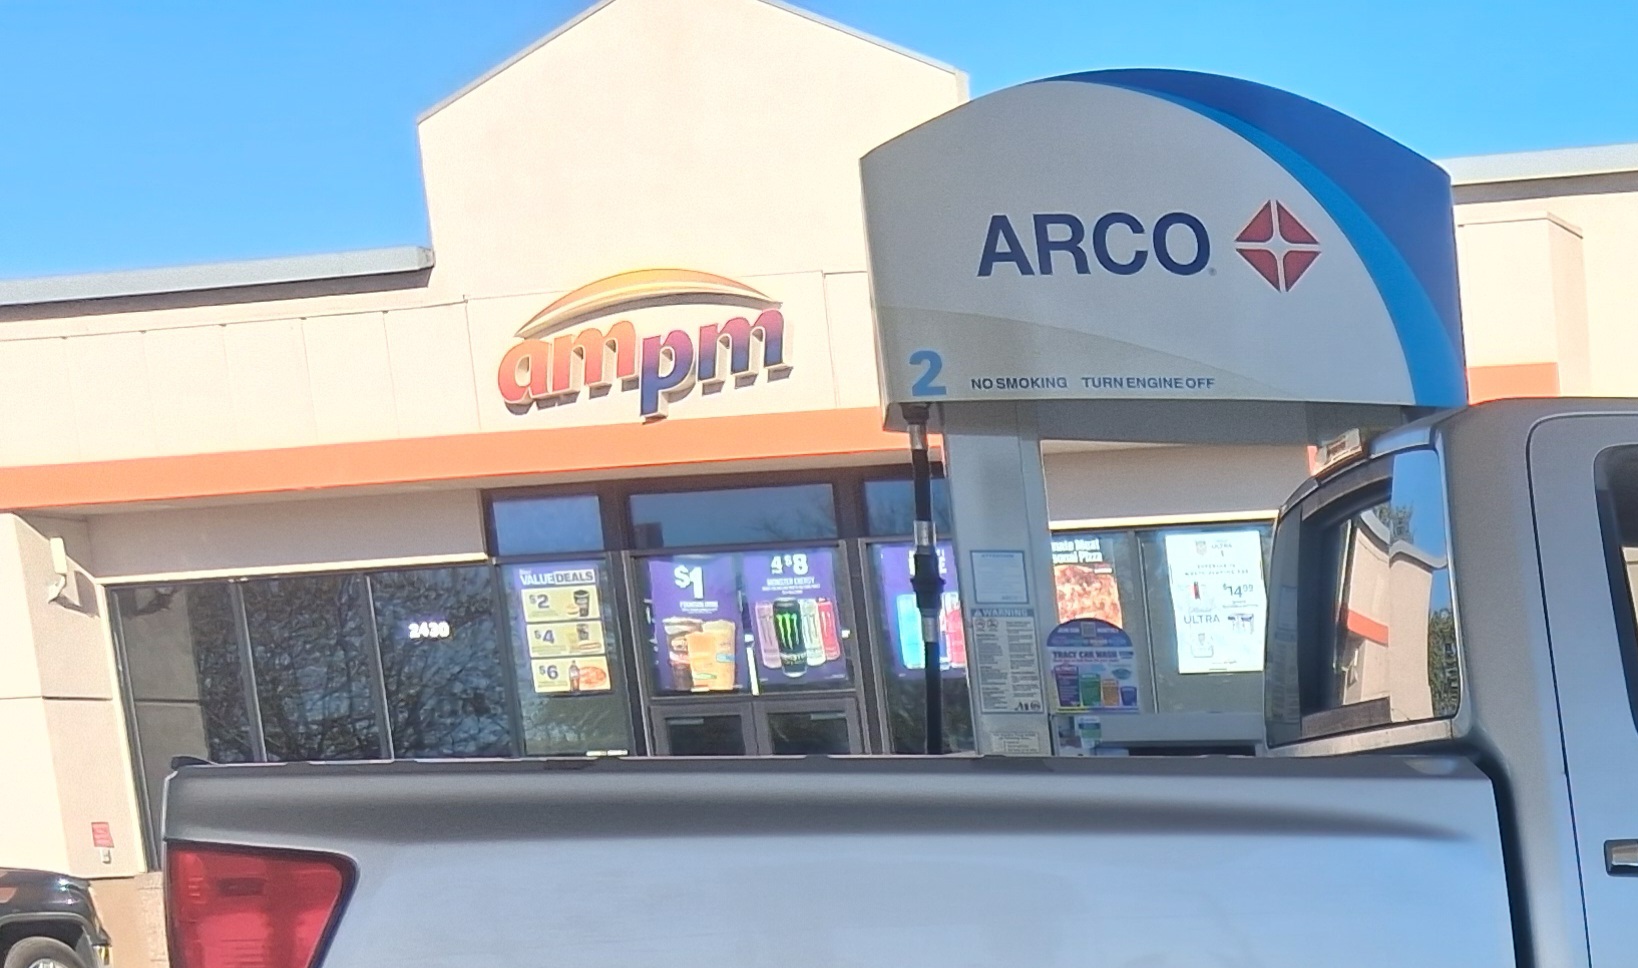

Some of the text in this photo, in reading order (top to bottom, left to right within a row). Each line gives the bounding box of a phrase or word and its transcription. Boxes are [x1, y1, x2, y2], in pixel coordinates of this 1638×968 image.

[977, 212, 1210, 277] ARCO
[498, 308, 786, 417] ampm
[909, 350, 947, 397] 2
[971, 376, 1216, 390] NO SMOKING TURN ENGINE OFF
[1078, 551, 1103, 563] Pizza
[520, 571, 594, 586] VALUE DEALS
[674, 564, 704, 599] $1
[529, 594, 549, 609] $2
[983, 608, 1028, 617] WARNING
[1183, 614, 1220, 625] ULTRA
[408, 621, 450, 639] 2430
[534, 630, 555, 644] $4
[539, 665, 559, 680] $6
